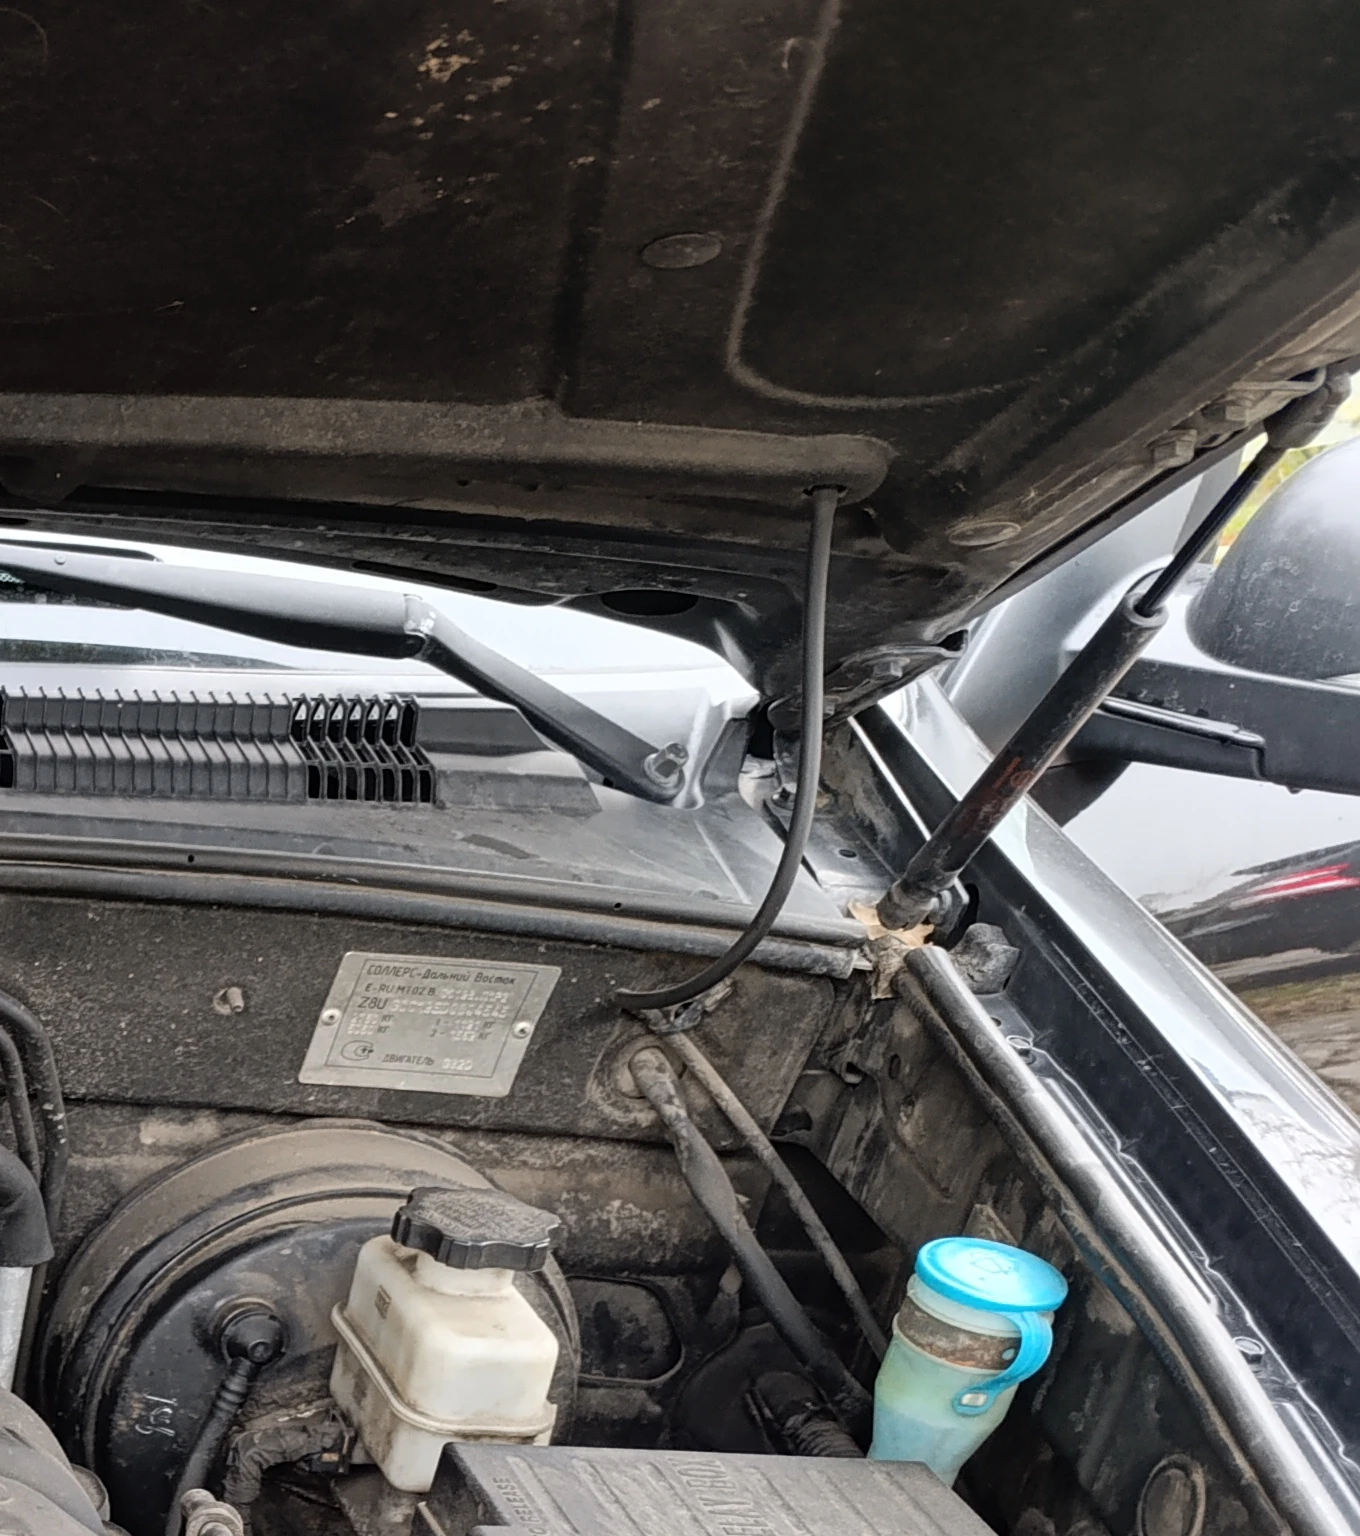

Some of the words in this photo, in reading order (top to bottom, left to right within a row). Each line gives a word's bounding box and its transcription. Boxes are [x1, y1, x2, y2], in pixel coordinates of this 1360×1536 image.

[366, 964, 470, 982] СОЛЛЕРС-Дальний
[473, 972, 517, 986] Восток
[357, 995, 390, 1010] Z8U
